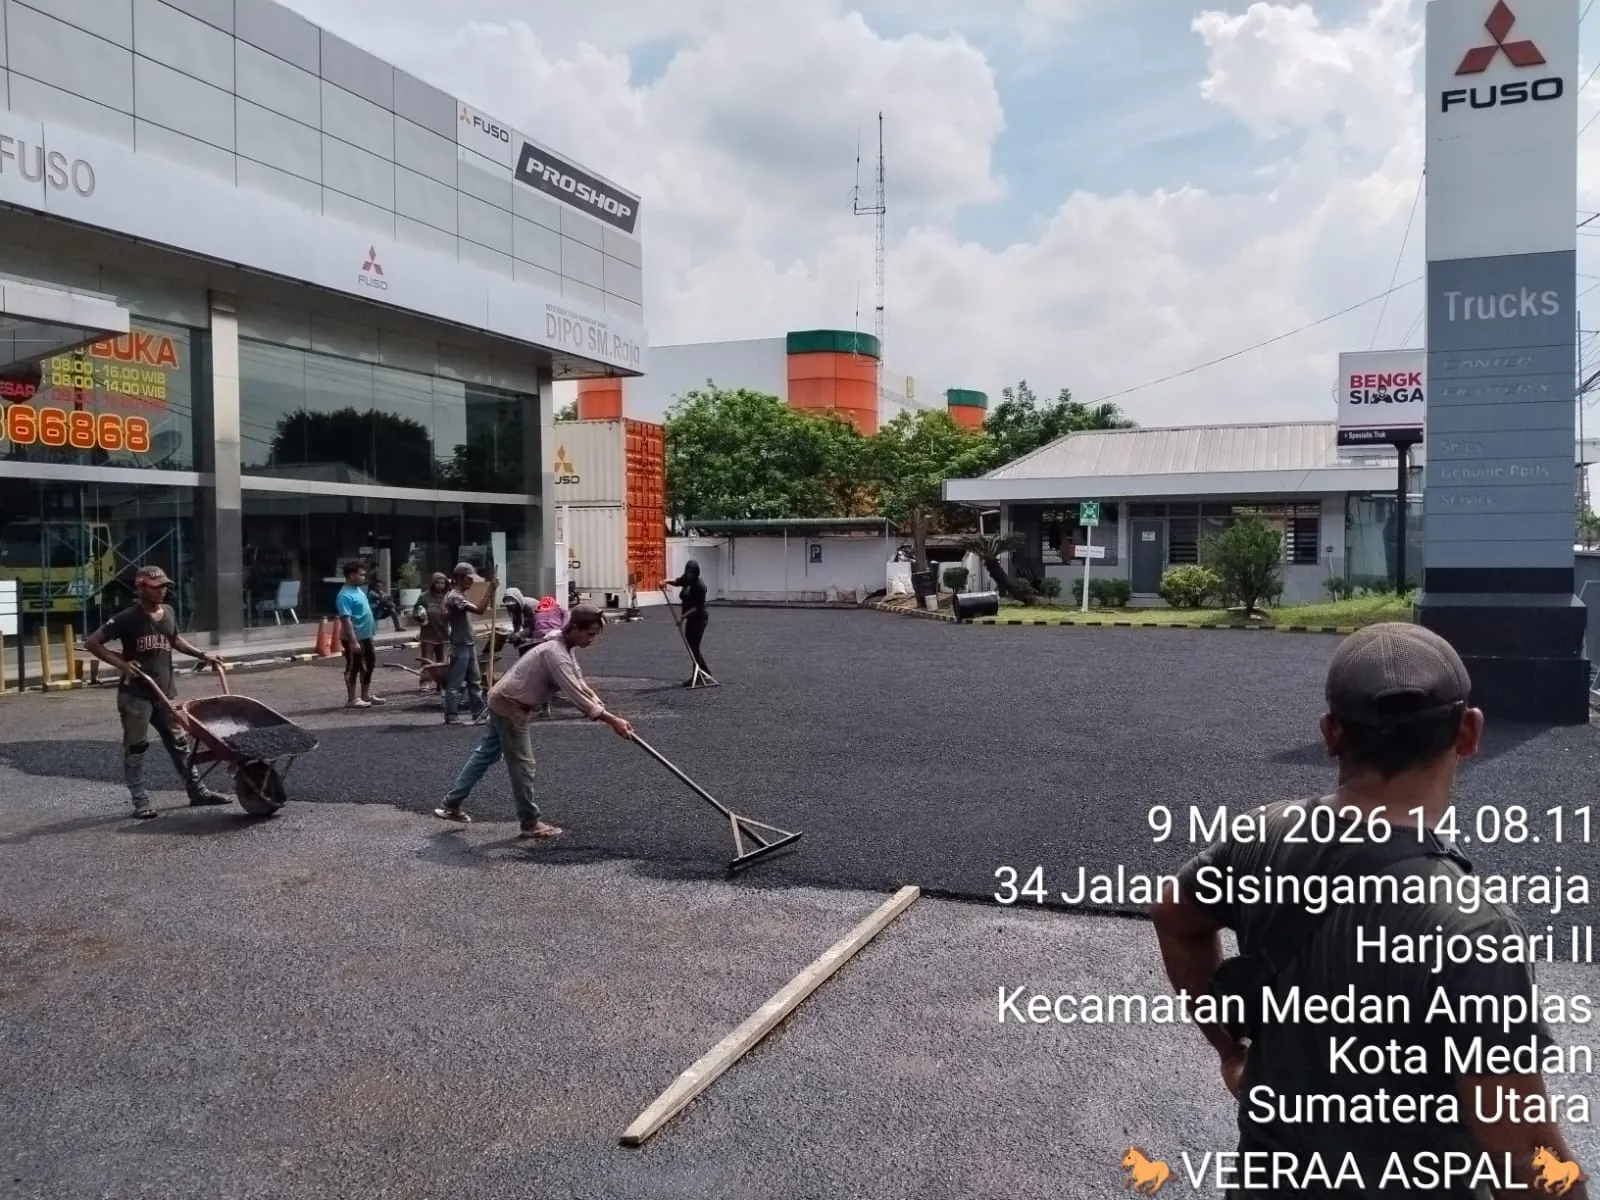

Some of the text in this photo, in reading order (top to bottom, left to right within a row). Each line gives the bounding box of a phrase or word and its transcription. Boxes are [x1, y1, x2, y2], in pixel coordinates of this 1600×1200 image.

[1441, 77, 1563, 112] FUSO
[473, 115, 510, 143] FUSO
[0, 133, 96, 198] FUSO
[525, 157, 632, 218] PROSHOP
[357, 274, 389, 291] FUSO
[1443, 286, 1560, 322] Trucks
[545, 312, 583, 347] DIPO
[51, 356, 94, 375] 08.00
[102, 363, 140, 381] 16.00
[141, 369, 166, 386] WIB
[51, 372, 94, 389] 08.00
[103, 379, 140, 396] 14.00
[141, 384, 167, 399] WIB
[1349, 372, 1423, 389] BENGK
[0, 402, 150, 453] 66868
[811, 546, 821, 559] P
